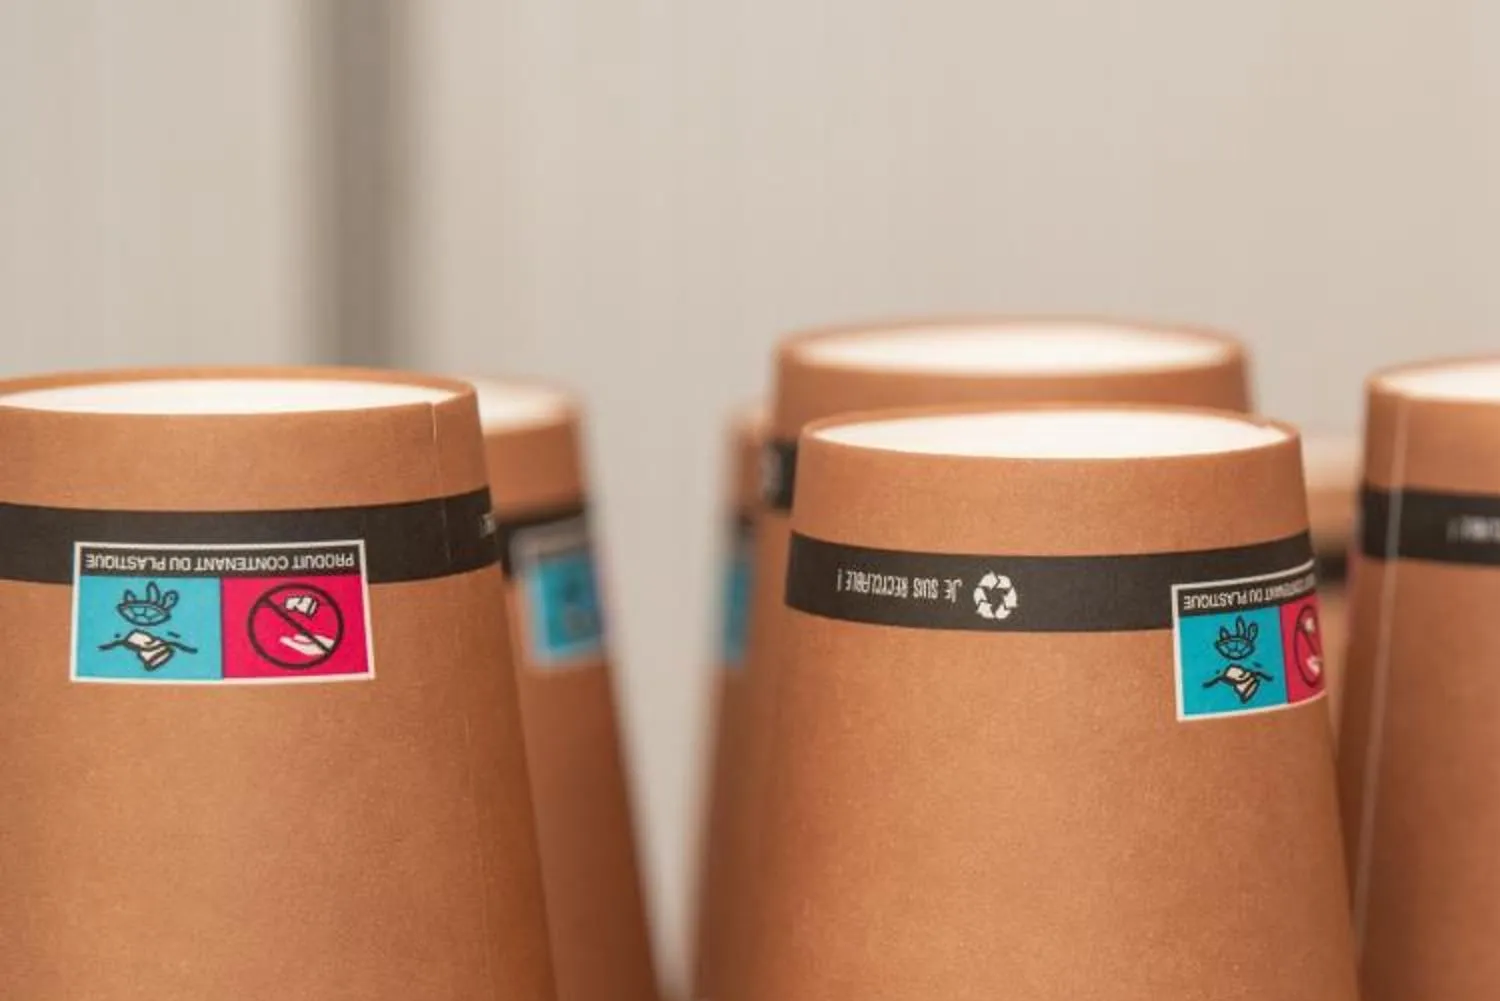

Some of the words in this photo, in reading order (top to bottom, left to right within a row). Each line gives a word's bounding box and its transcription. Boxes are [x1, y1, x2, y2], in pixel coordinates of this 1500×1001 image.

[85, 553, 167, 570] PLASTIQUE
[169, 555, 191, 570] DU
[194, 556, 289, 571] CONTENANT
[291, 554, 355, 570] PRODUIT
[845, 570, 909, 599] RECYCLABLE
[913, 576, 939, 600] SUIS
[944, 579, 962, 603] JE
[1183, 590, 1247, 610] PLASTIQUE
[1249, 588, 1262, 603] DU
